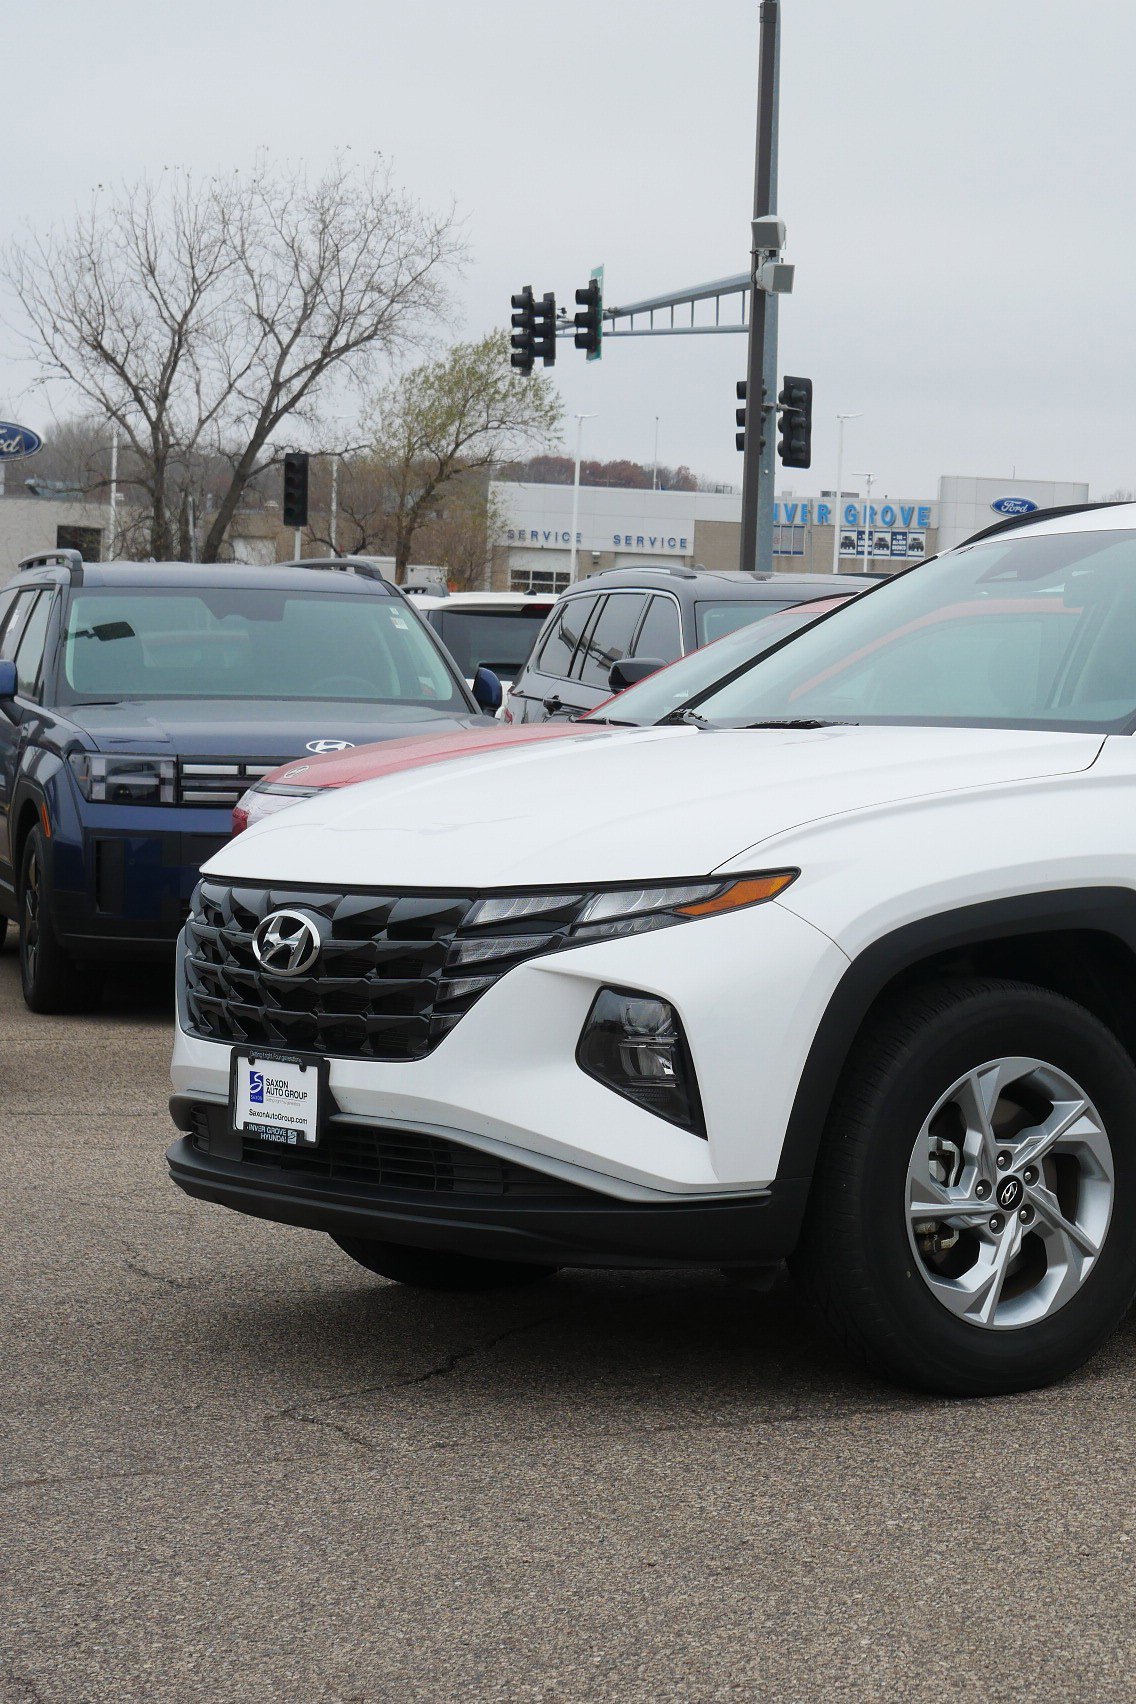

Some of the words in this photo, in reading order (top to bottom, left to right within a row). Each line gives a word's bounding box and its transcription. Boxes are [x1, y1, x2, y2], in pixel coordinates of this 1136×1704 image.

[1001, 500, 1029, 513] Ford
[844, 504, 931, 528] GROVE
[507, 529, 582, 544] SERVICE
[613, 534, 687, 548] SERVICE
[265, 1078, 289, 1089] SAXON
[265, 1087, 284, 1096] AUTO
[284, 1089, 308, 1100] GROUP
[248, 1108, 308, 1125] SaxonAutoGroup.com
[248, 1123, 266, 1132] INVER
[266, 1126, 287, 1135] GROVE
[260, 1133, 287, 1143] HYUNDAI
